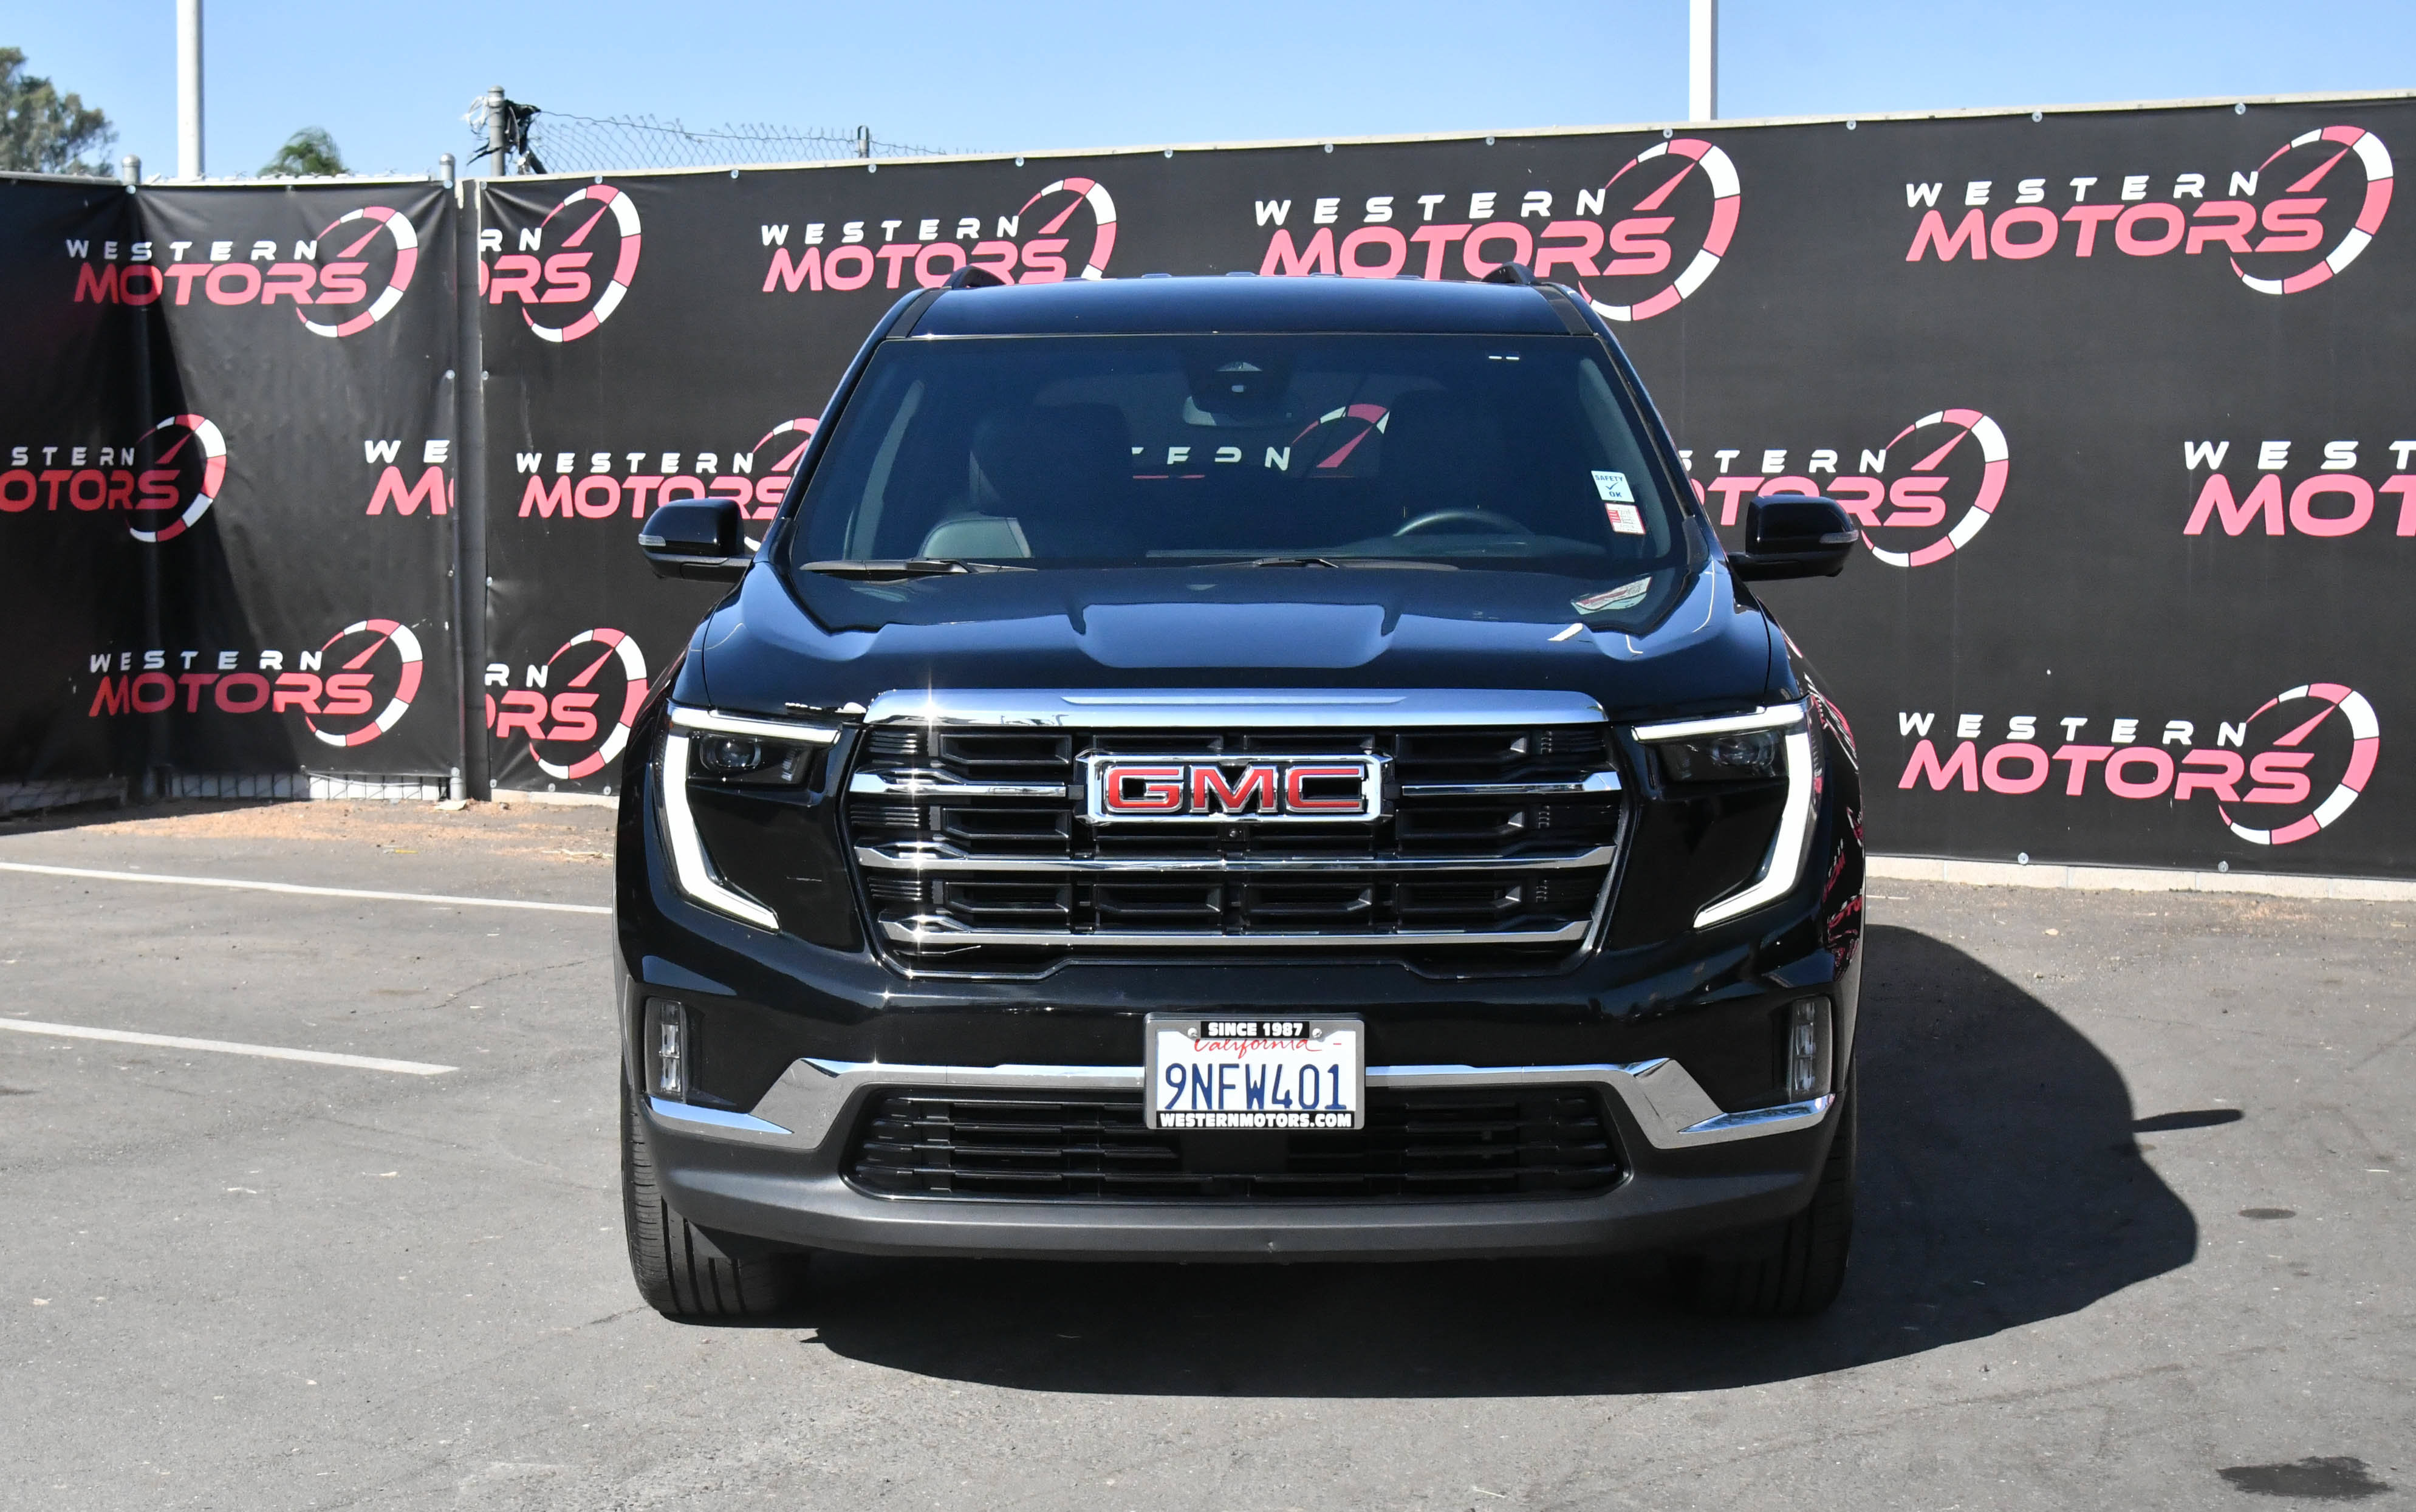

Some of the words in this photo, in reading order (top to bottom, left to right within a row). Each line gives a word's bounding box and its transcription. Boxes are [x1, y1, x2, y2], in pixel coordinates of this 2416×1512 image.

[1255, 188, 1606, 227] WESTERN
[1906, 171, 2259, 208] WESTERN
[66, 239, 318, 262] WESTERN
[761, 215, 1020, 246] WESTERN
[1258, 216, 1675, 281] MOTORS
[1906, 197, 2329, 262] MOTORS
[74, 261, 369, 306] MOTORS
[479, 251, 594, 305] RS
[762, 238, 1070, 293] MOTORS
[11, 446, 135, 467] STERN
[364, 439, 451, 464] WE
[516, 452, 754, 474] WESTERN
[2184, 440, 2416, 470] WEST
[0, 468, 180, 513] OTORS
[366, 465, 454, 516] M
[89, 649, 323, 674] WESTERN
[88, 671, 375, 717] MOTORS
[486, 689, 601, 743] RS
[1898, 711, 2247, 747] WESTERN
[1104, 764, 1364, 813] GMC
[1898, 738, 2315, 804] MOTORS
[1208, 1022, 1258, 1037] SINCE
[1262, 1022, 1304, 1037] 1987
[1164, 1063, 1347, 1110] 9NFW401
[1160, 1112, 1352, 1128] WESTERNMOTORS.COM
